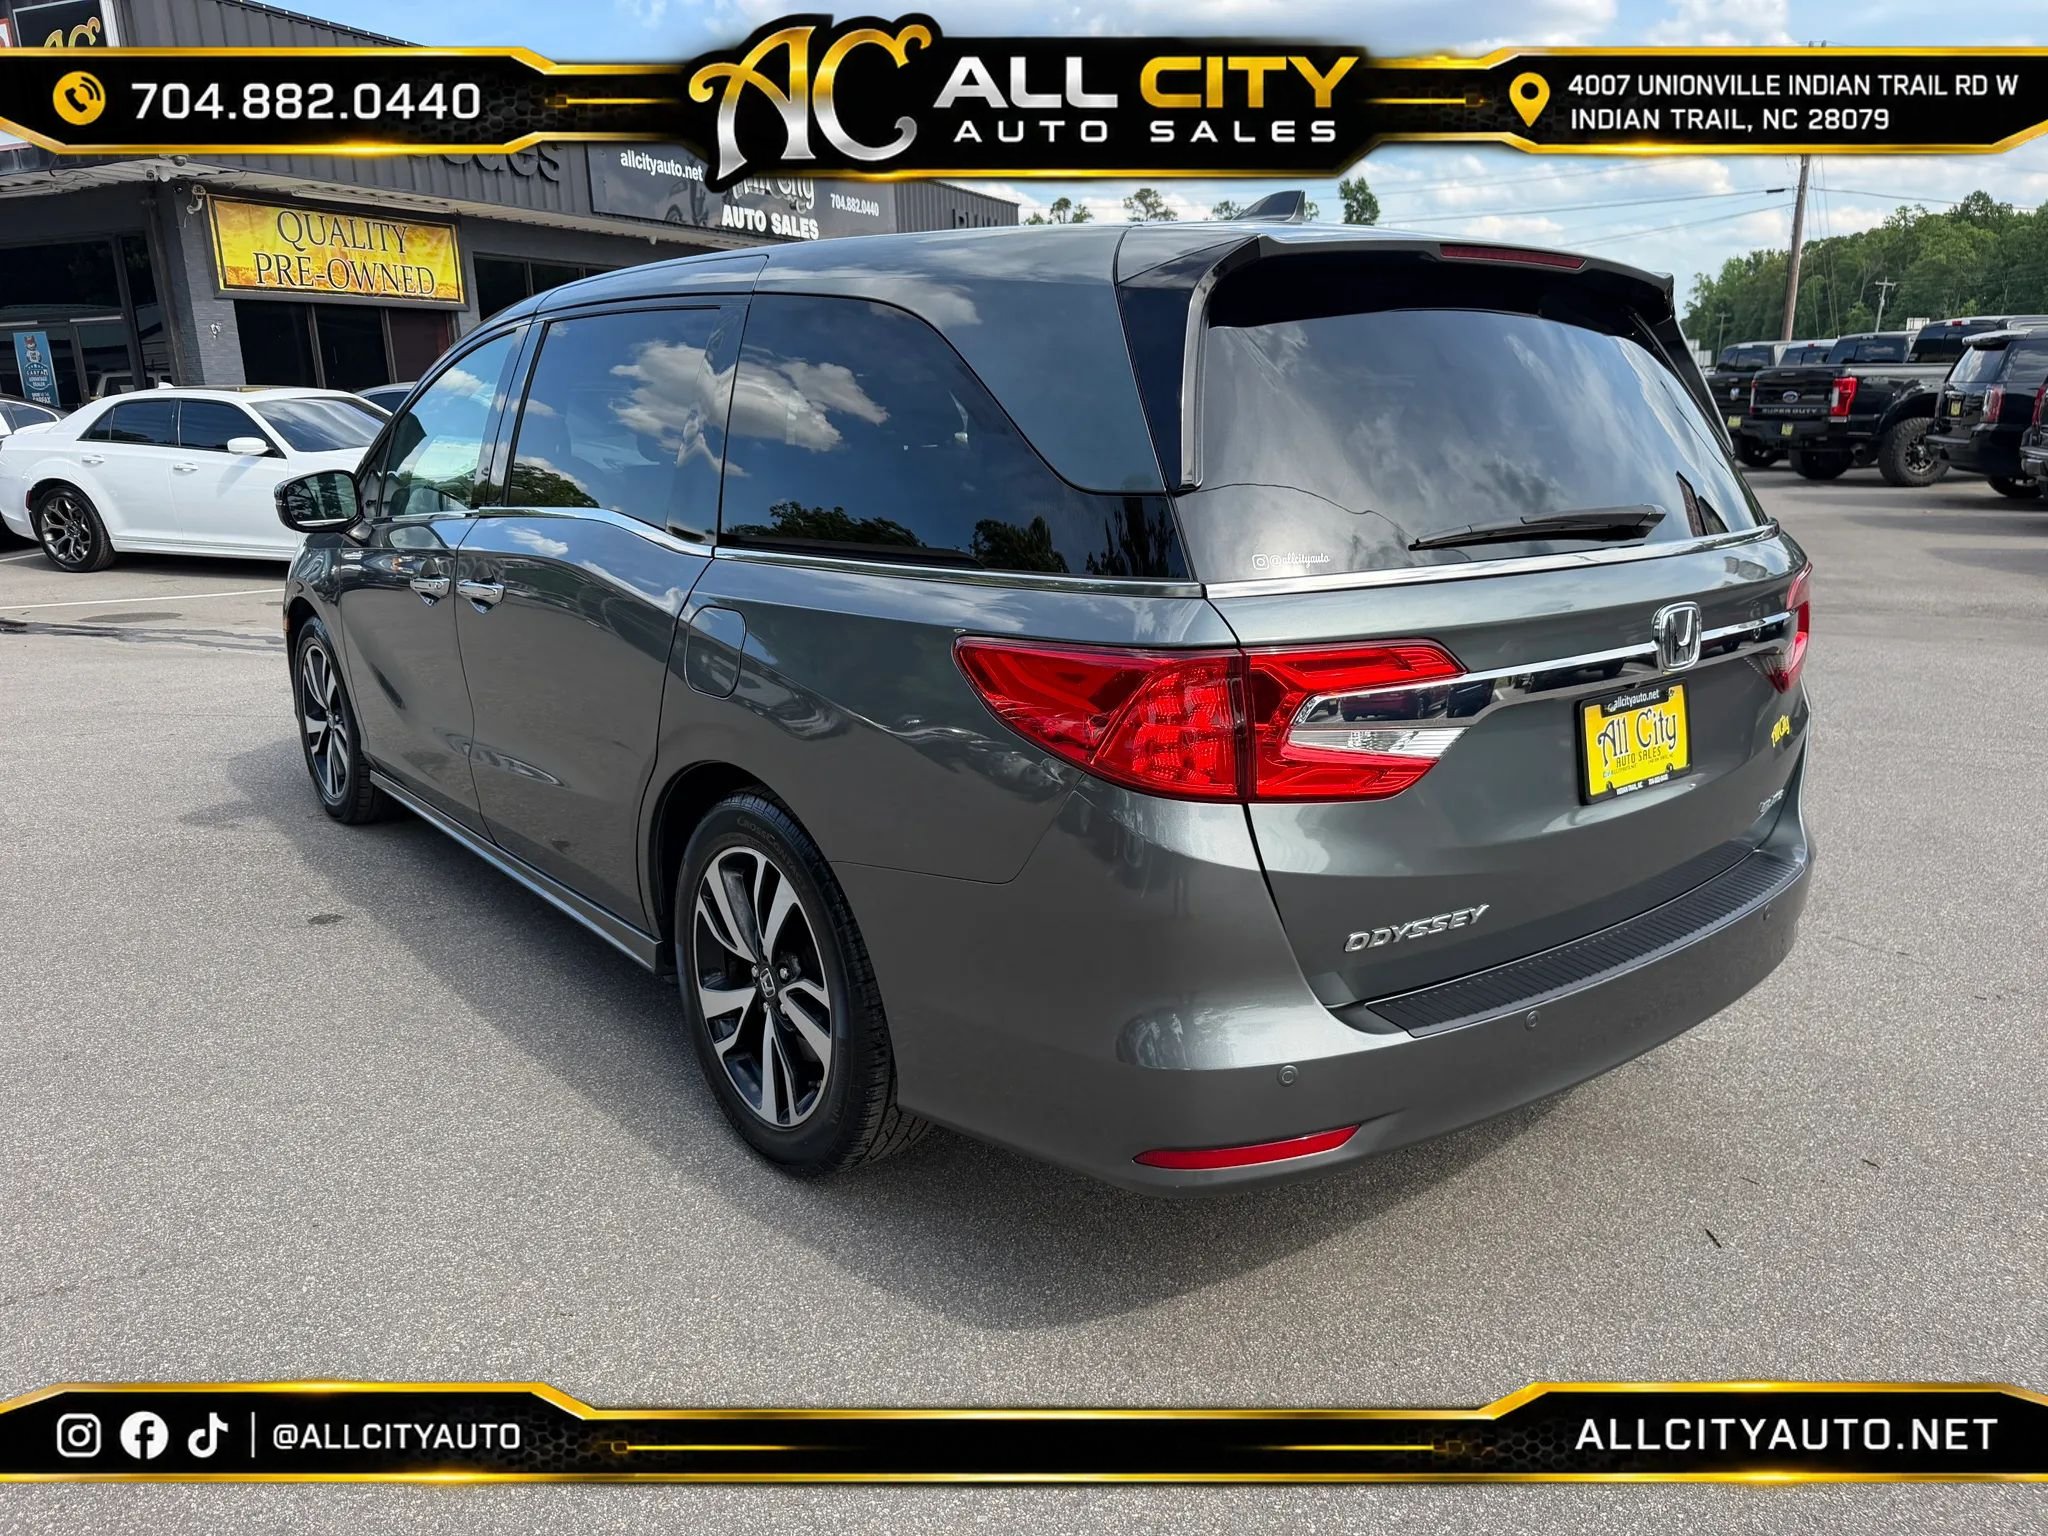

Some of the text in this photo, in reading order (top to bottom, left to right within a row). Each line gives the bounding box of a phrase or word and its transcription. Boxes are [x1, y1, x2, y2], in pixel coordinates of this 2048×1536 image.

[620, 150, 703, 181] allcityauto.net
[830, 193, 879, 217] 704.882.0440
[277, 210, 408, 254] QUALITY
[722, 205, 819, 240] AUTO SALES
[253, 252, 435, 295] PRE-OWNED
[1269, 552, 1330, 569] @allcityauto
[1613, 689, 1660, 708] allcityauto.net
[1597, 707, 1677, 768] All City
[1616, 752, 1636, 768] AUTO
[1638, 746, 1661, 762] SALES
[1344, 903, 1490, 952] ODYSSEY
